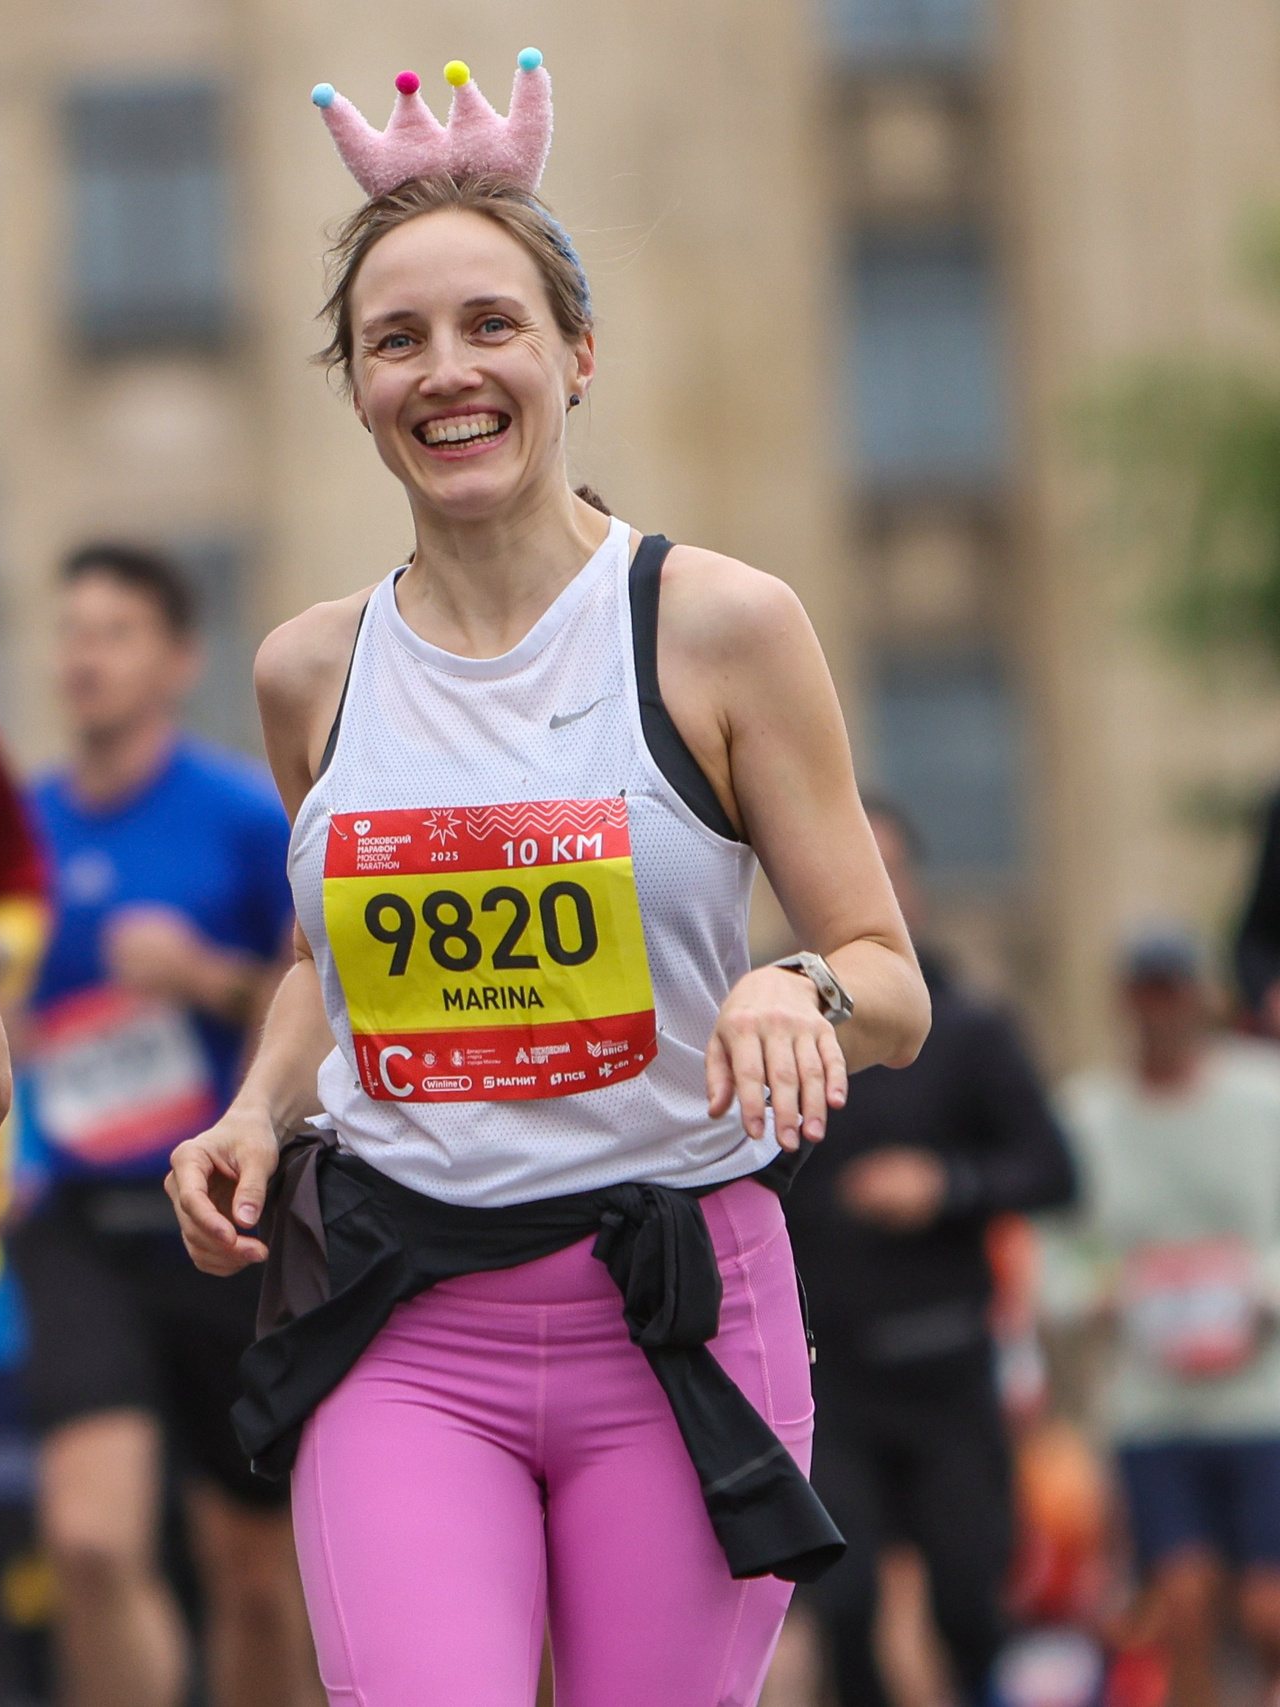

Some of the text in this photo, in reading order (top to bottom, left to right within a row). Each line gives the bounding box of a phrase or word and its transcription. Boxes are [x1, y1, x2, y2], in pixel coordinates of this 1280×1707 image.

[357, 834, 412, 846] МОСКОВСКИЙ
[357, 845, 397, 854] МАРАФОН
[501, 833, 603, 866] 10 KM
[356, 853, 392, 862] MOSCOW
[431, 851, 459, 862] 2025
[356, 861, 401, 871] MARATHON
[364, 881, 599, 977] 9820
[442, 986, 545, 1011] MARINA
[496, 1076, 537, 1087] МАГНИТ
[564, 1071, 587, 1082] ПСБ
[426, 1079, 459, 1089] Winline
